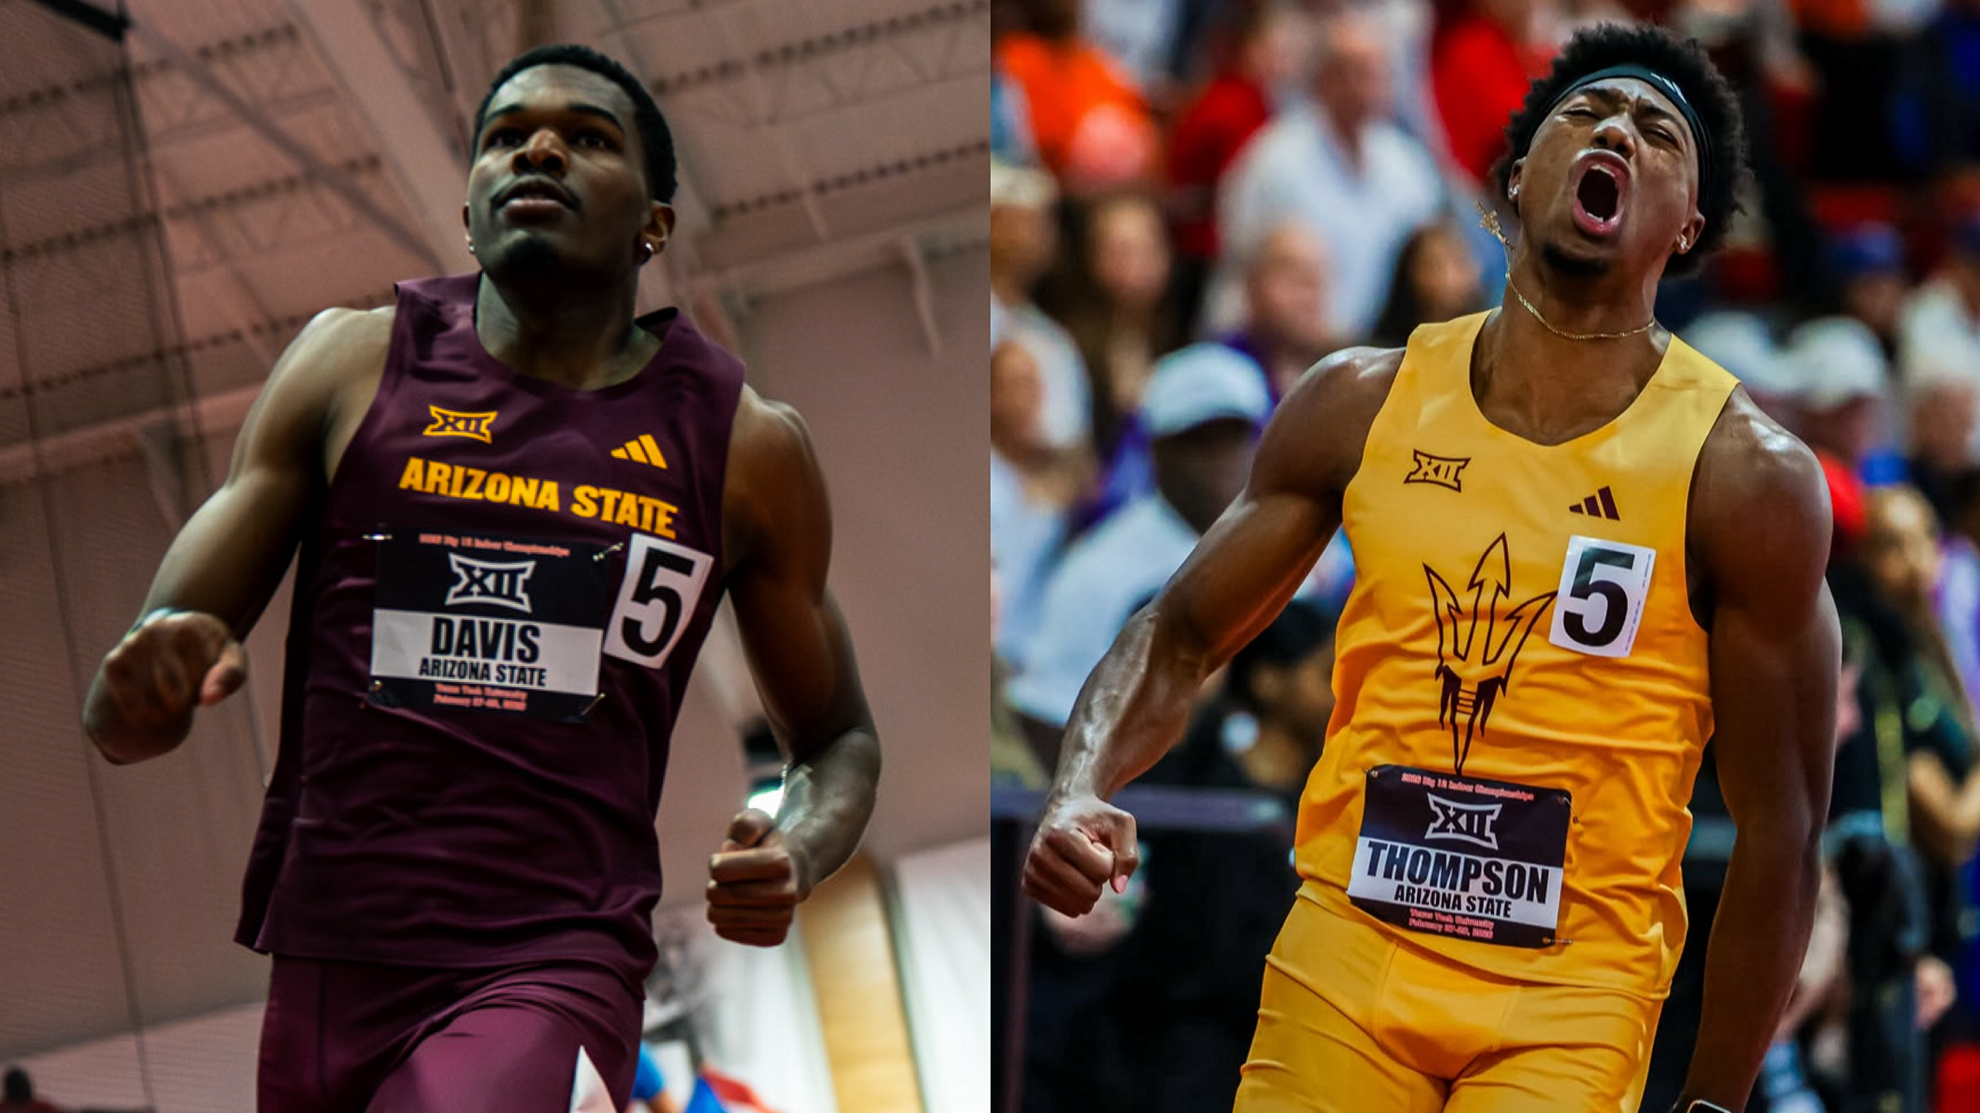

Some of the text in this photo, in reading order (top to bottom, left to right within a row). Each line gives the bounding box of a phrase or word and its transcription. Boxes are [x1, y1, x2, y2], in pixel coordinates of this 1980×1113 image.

[399, 457, 679, 539] ARIZONA STATE
[1404, 449, 1471, 493] XII
[445, 552, 537, 613] XII
[622, 546, 695, 657] 5
[1563, 546, 1635, 647] 5
[431, 617, 541, 663] DAVIS
[418, 657, 547, 687] ARIZONA STATE
[1424, 792, 1502, 850] XII
[1367, 841, 1549, 904] THOMPSON
[1394, 884, 1512, 918] ARIZONA STATE
